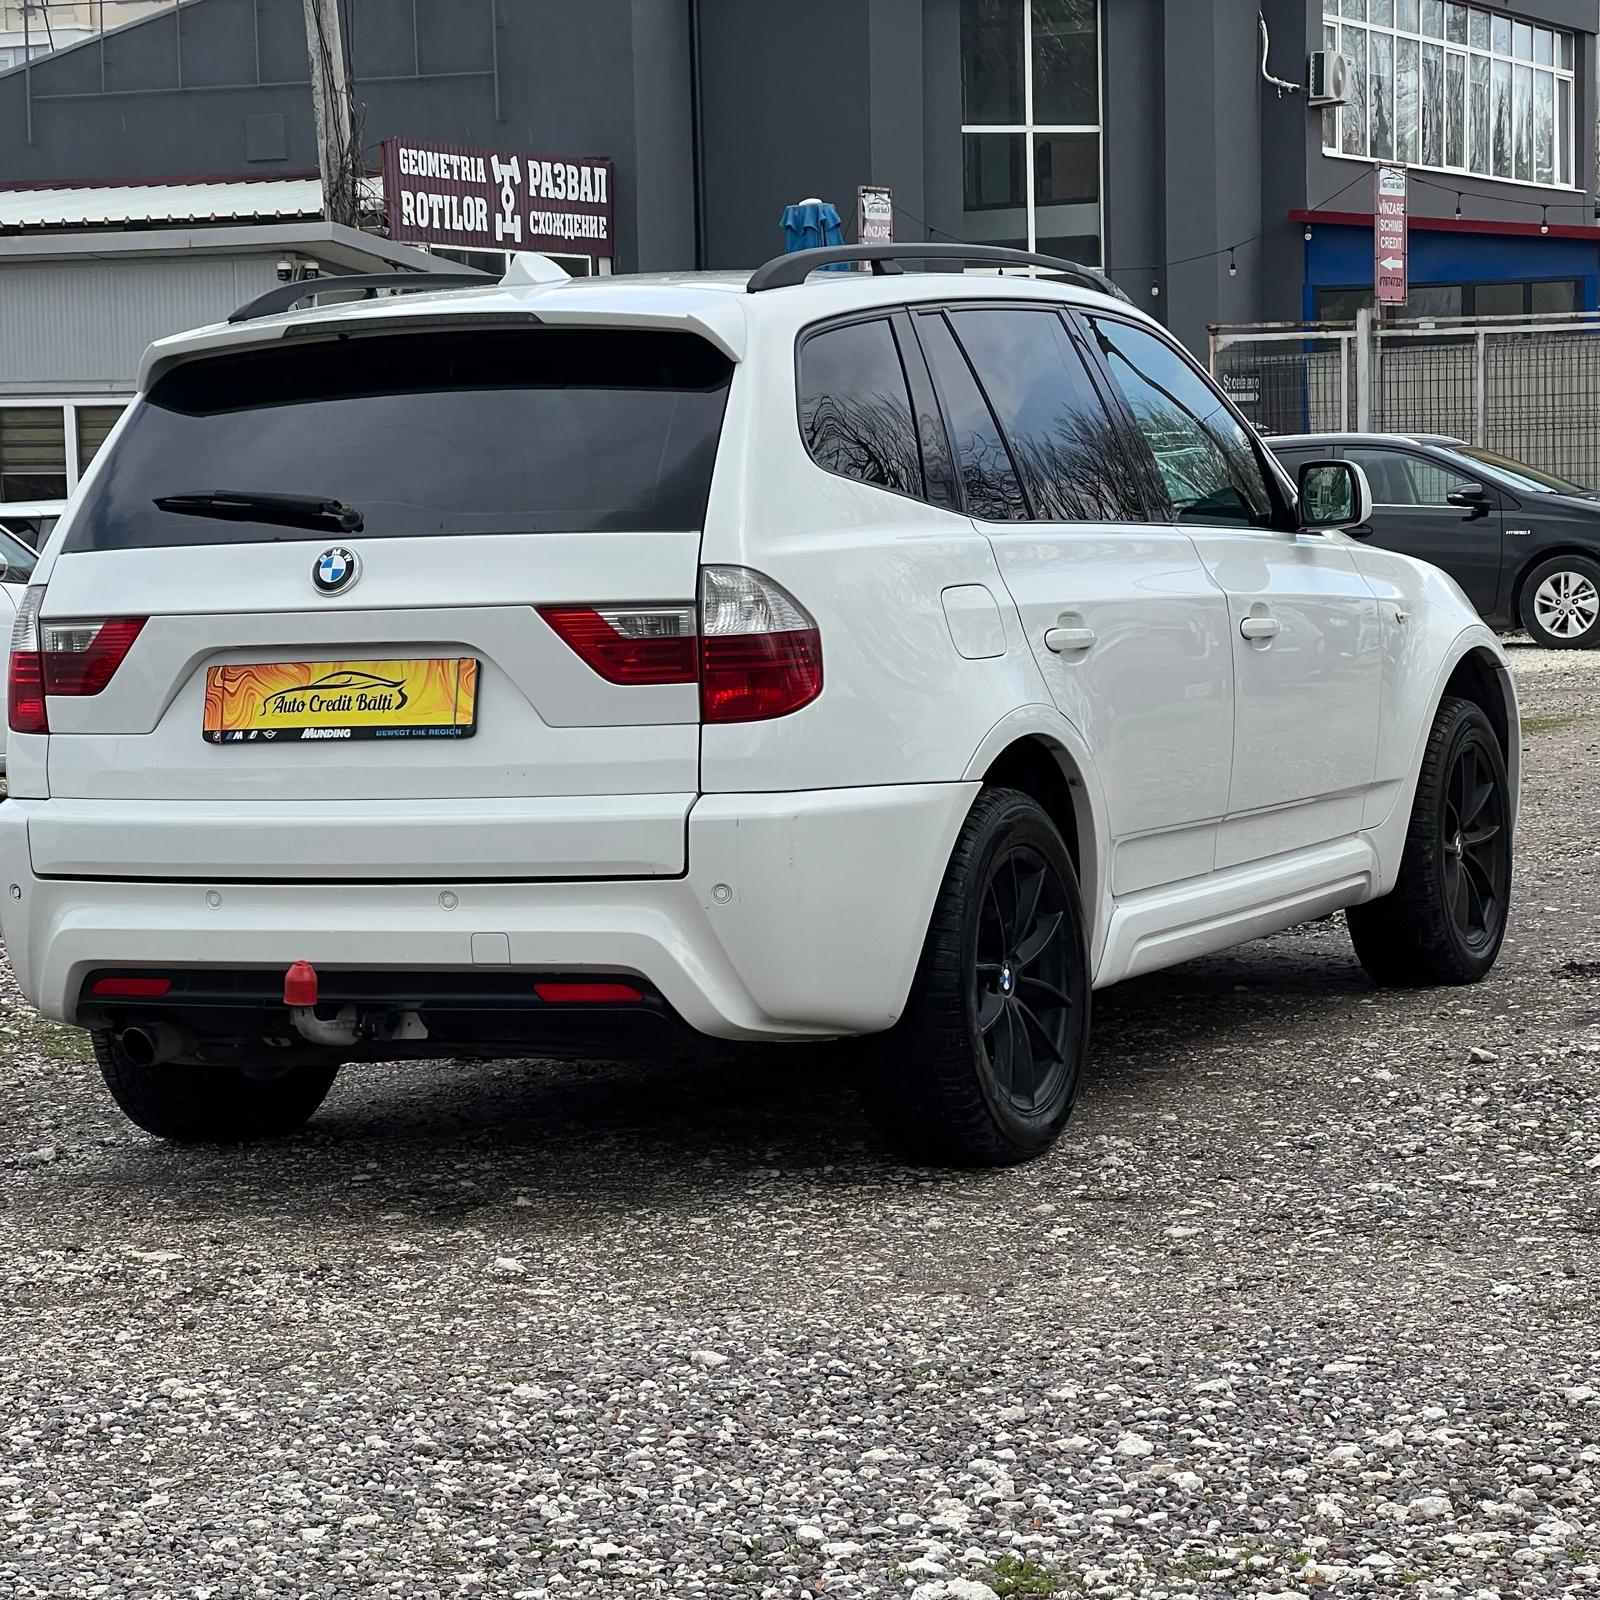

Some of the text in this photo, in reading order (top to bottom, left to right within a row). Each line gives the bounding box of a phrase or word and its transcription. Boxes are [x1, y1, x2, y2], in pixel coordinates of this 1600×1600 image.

[399, 148, 487, 183] GEOMETRIA
[527, 160, 607, 204] РАЗВАЛ
[401, 190, 488, 232] ROTILOR
[529, 210, 607, 240] СХОЖДЕНИЕ
[1380, 219, 1403, 233] SCHIMB
[1380, 236, 1402, 250] CREDIT
[272, 696, 306, 713] Auto
[309, 694, 353, 712] Credit
[428, 728, 462, 736] REGION
